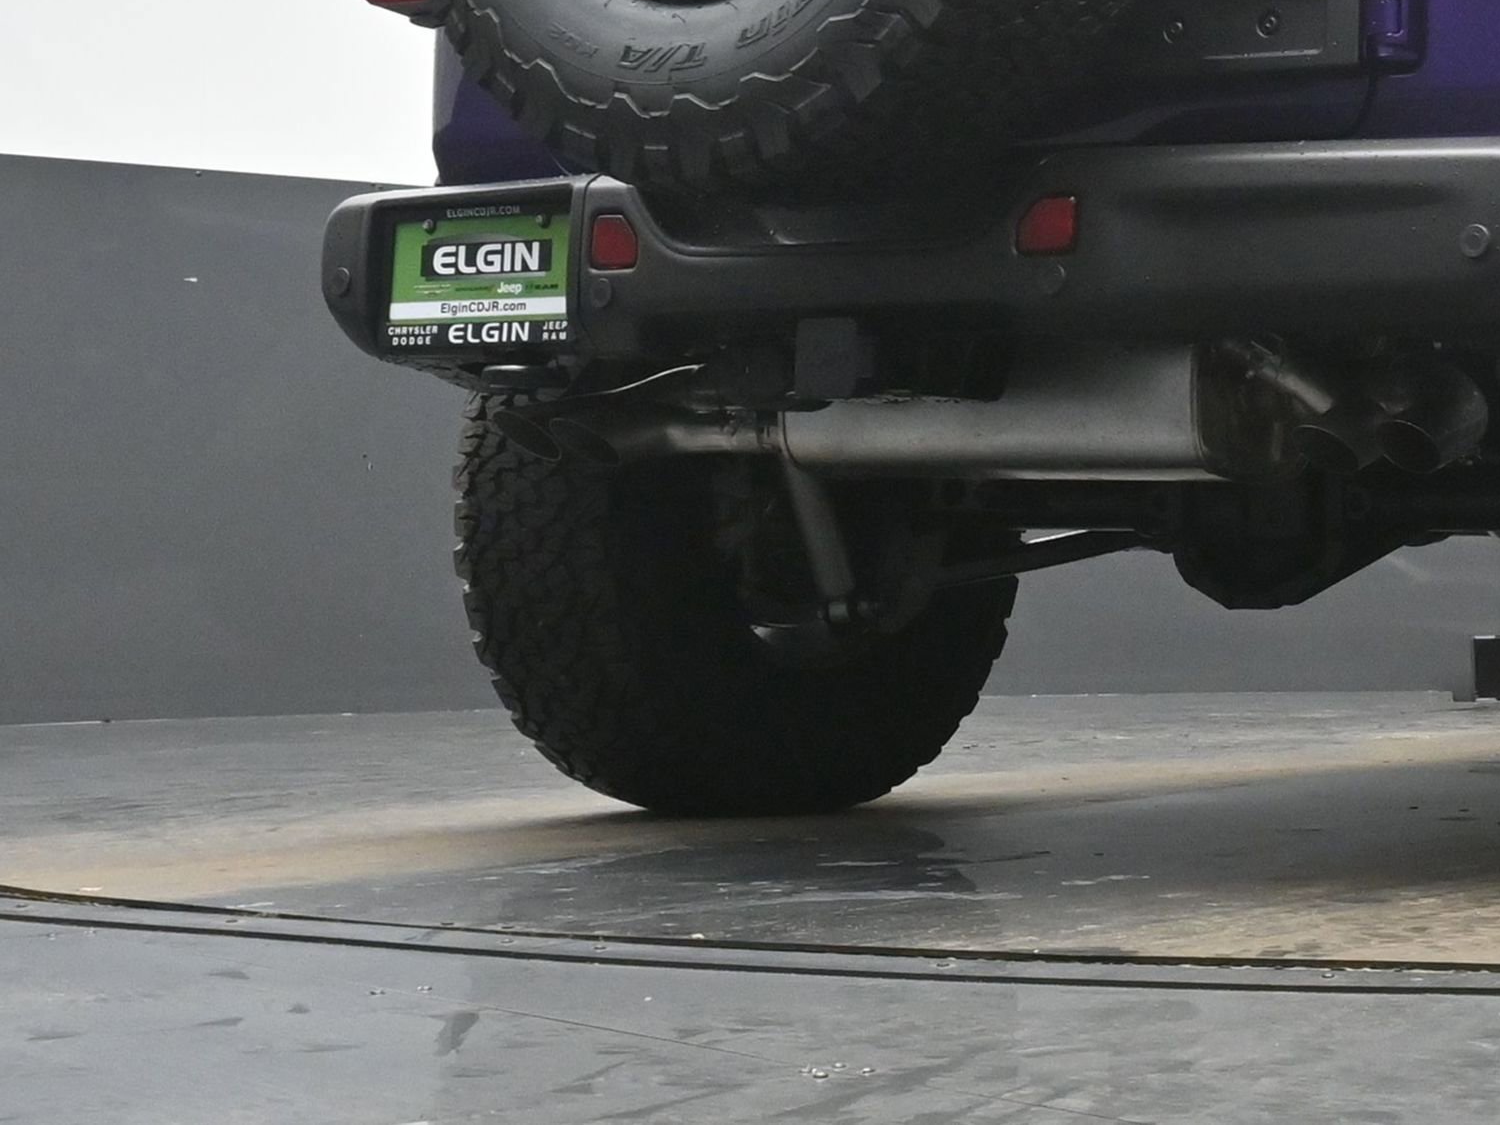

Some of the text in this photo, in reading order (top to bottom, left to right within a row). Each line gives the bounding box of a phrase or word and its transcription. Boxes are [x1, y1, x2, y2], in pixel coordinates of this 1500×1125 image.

[432, 241, 540, 275] ELGIN
[497, 282, 522, 295] Jeep
[440, 301, 527, 316] ElginCDJR.com
[387, 324, 438, 336] CHRYSLER
[542, 321, 568, 330] JEEP
[447, 322, 530, 344] ELGIN
[542, 332, 567, 341] RAM
[391, 336, 431, 346] DODGE
